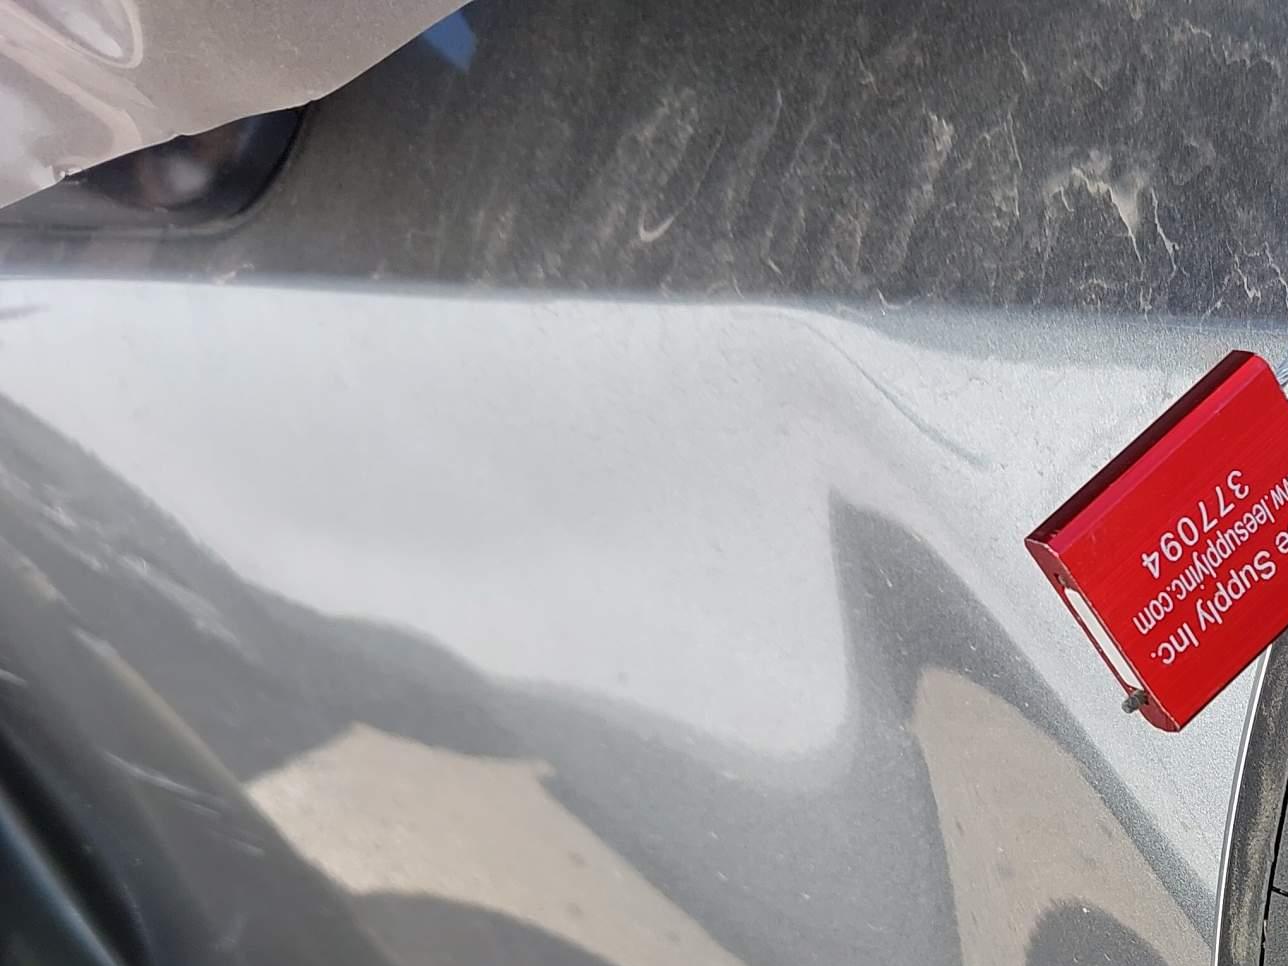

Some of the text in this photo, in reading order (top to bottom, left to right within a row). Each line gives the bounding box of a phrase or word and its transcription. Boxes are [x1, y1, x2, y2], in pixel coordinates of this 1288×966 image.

[1141, 470, 1250, 579] 377094
[1196, 550, 1277, 632] Supply
[1150, 623, 1200, 665] Inc.
